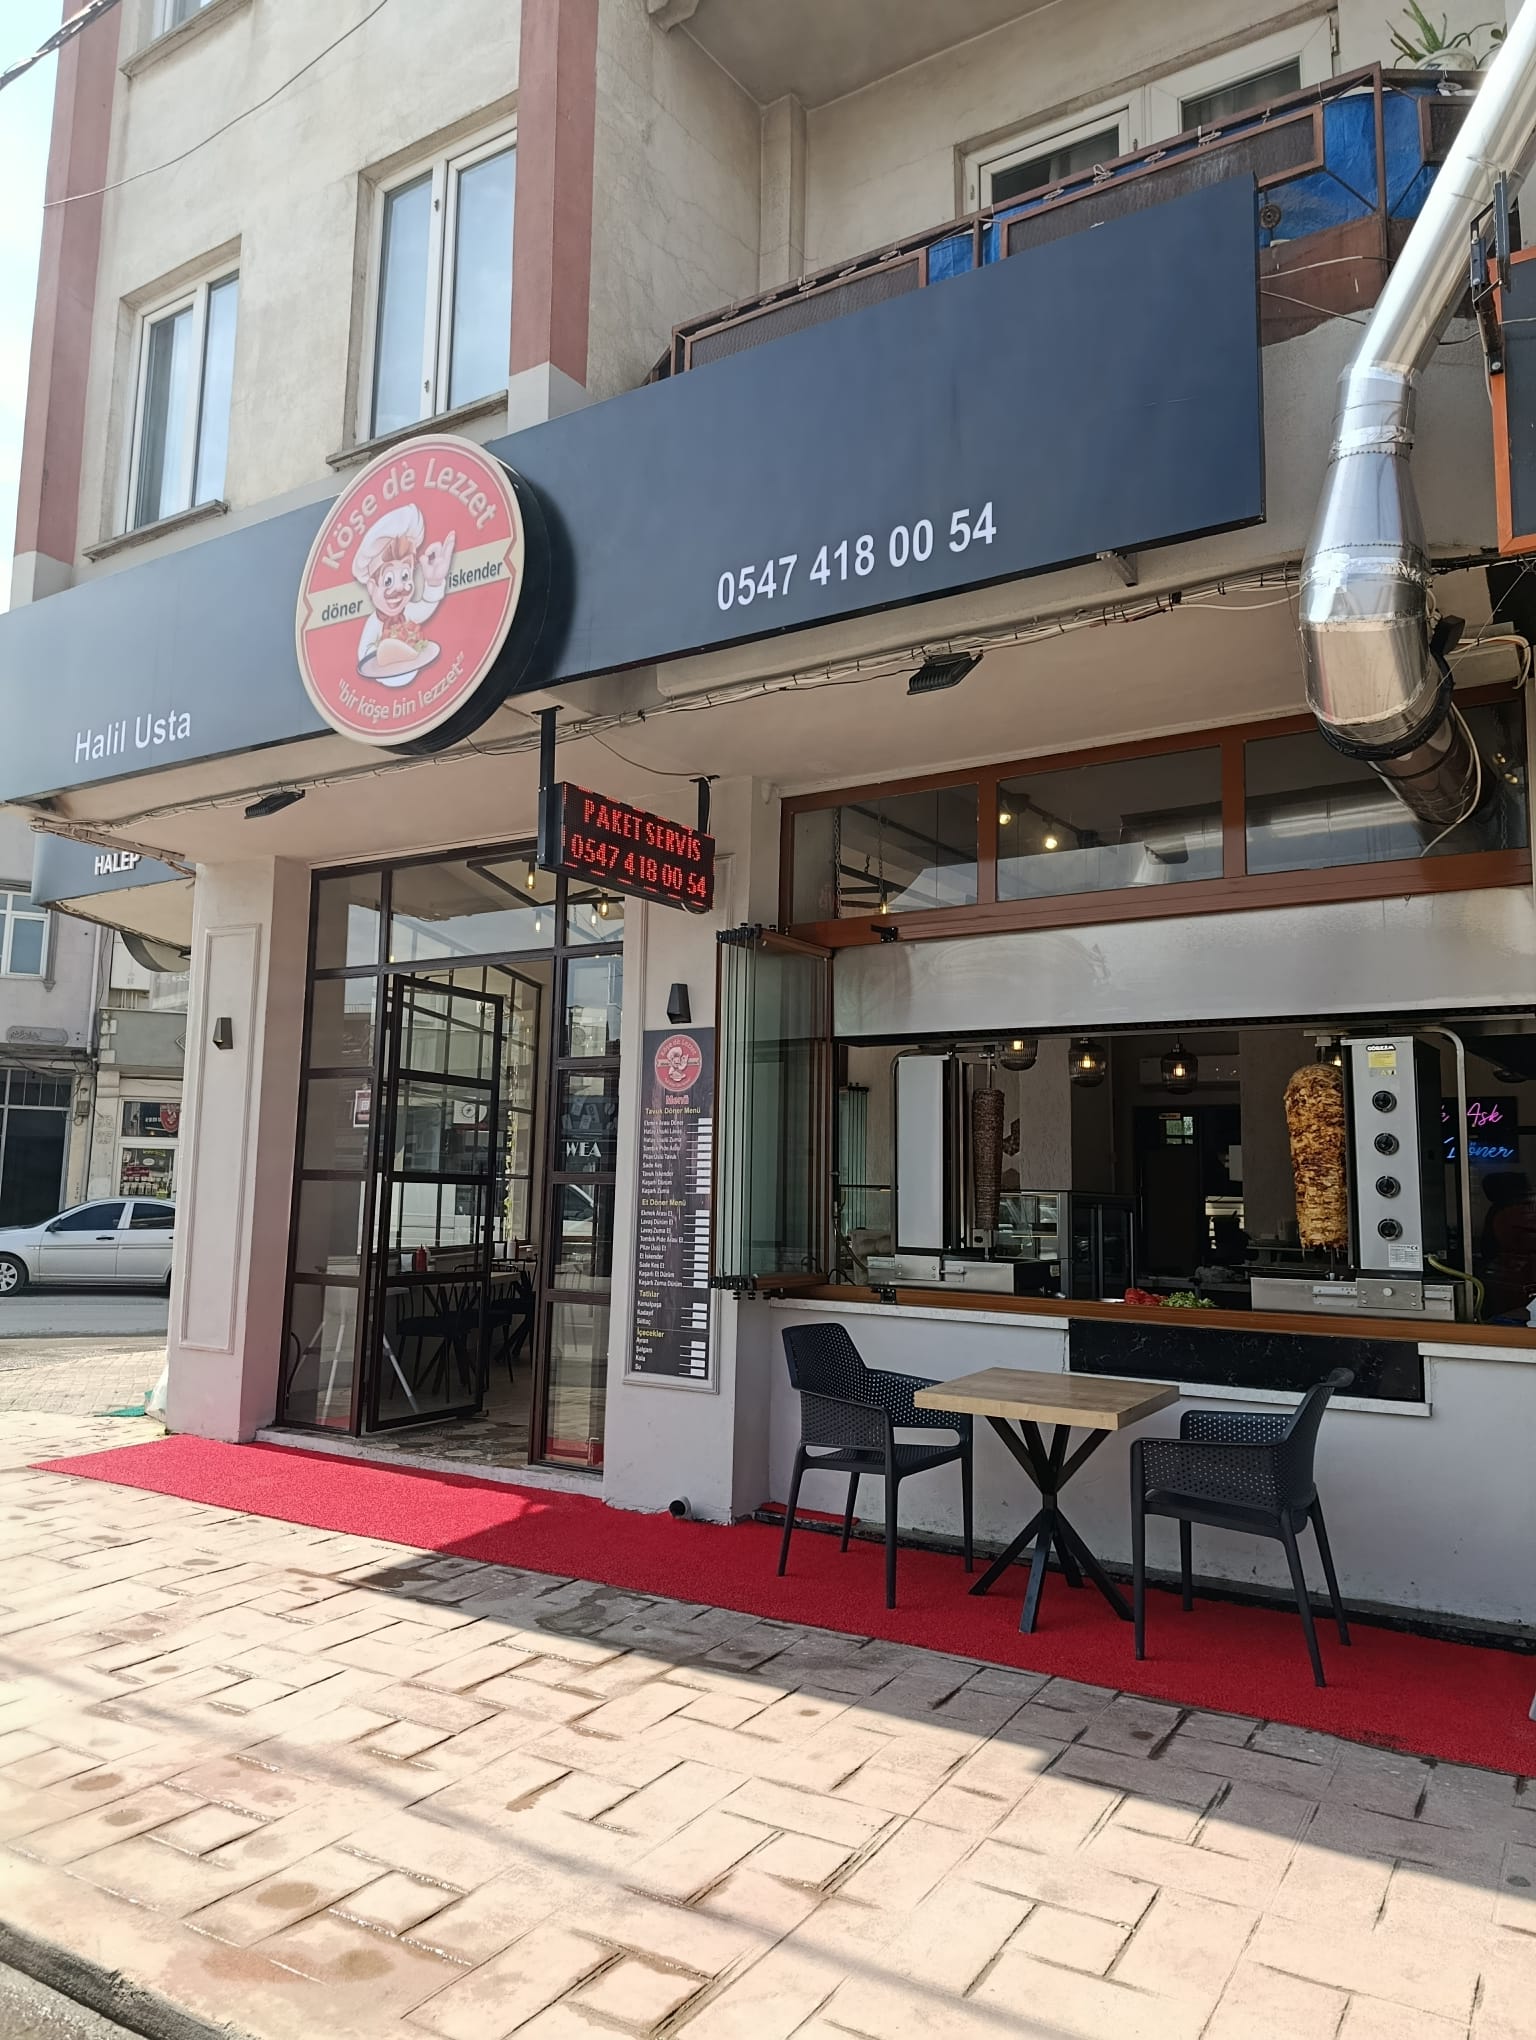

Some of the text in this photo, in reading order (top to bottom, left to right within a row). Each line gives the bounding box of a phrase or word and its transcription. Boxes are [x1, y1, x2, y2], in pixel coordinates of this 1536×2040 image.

[322, 493, 379, 571] Köşe
[423, 458, 497, 530] Lezzet
[717, 501, 997, 611] 0547 418 00 54
[448, 561, 503, 589] iskender
[321, 599, 363, 622] döner
[358, 693, 389, 724] köşe
[393, 695, 416, 718] bin
[74, 709, 191, 764] Halil Usta
[584, 799, 701, 861] PAKET SERVİS
[94, 850, 141, 876] HALEP
[570, 833, 707, 897] 0547 418 00 54
[566, 1141, 602, 1158] WEA
[637, 1327, 664, 1337] İçecekler
